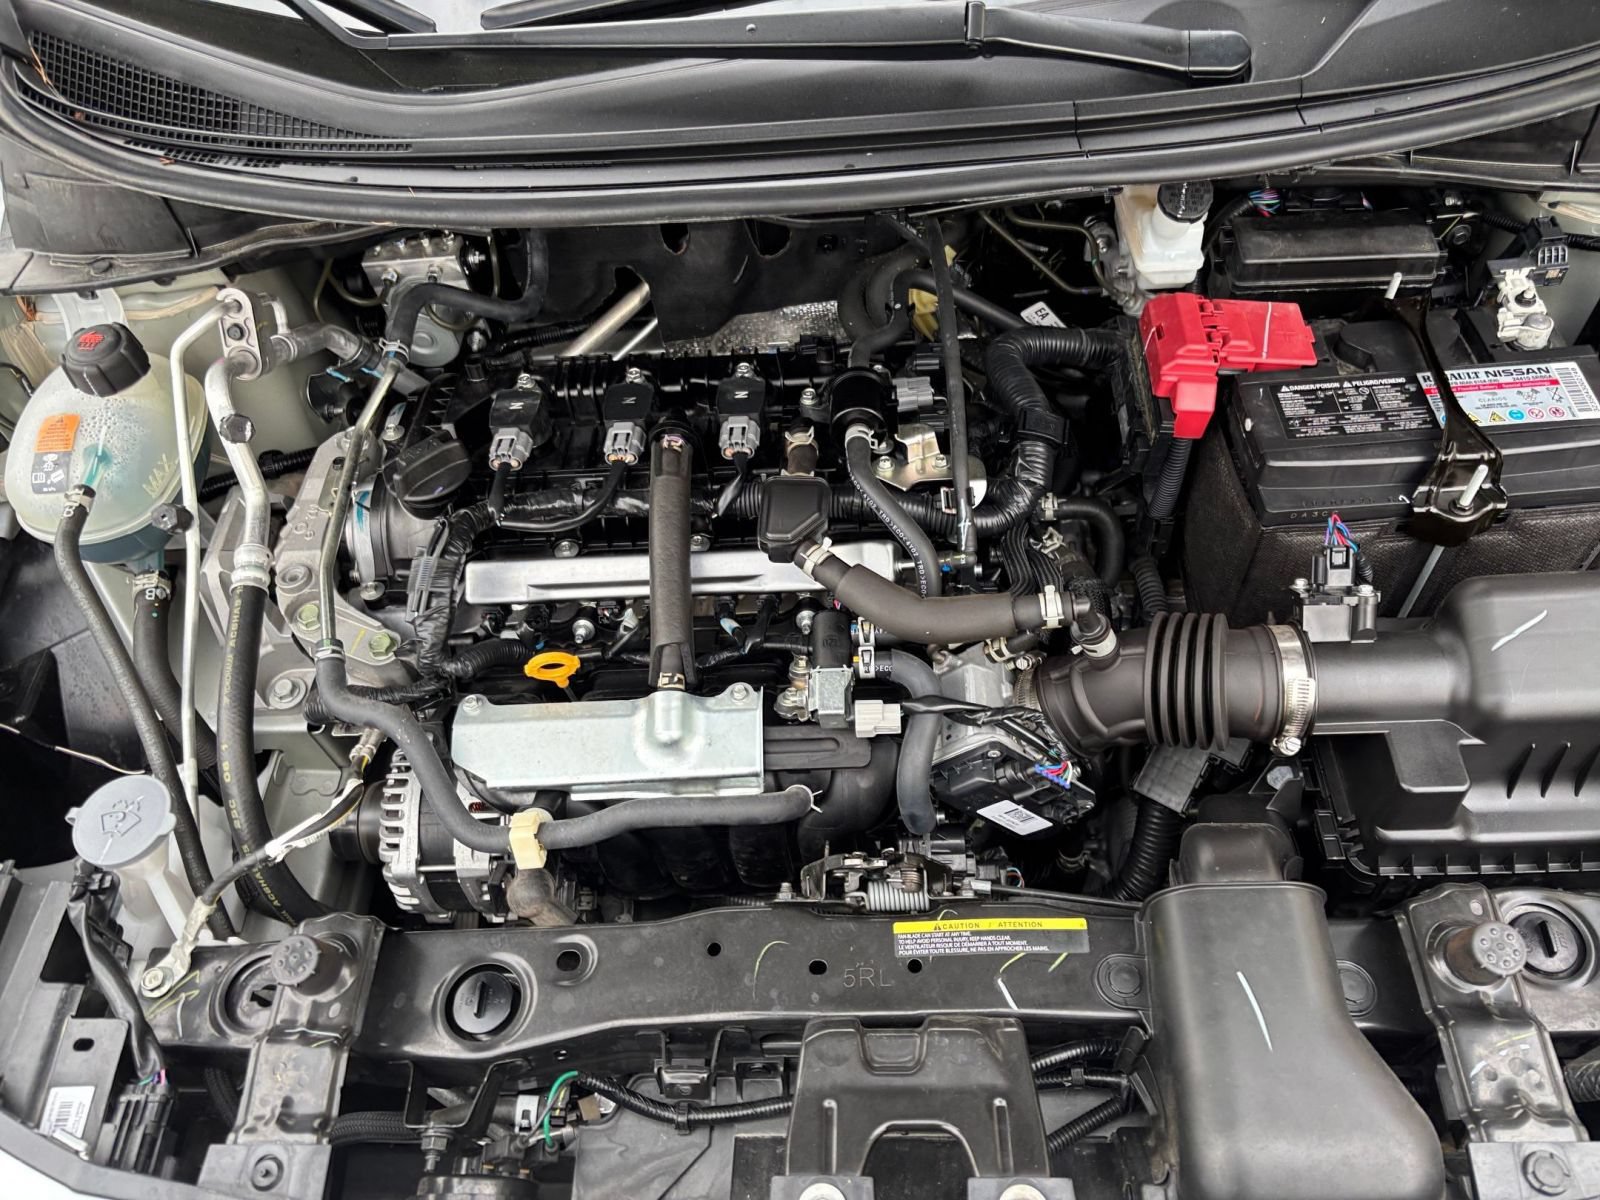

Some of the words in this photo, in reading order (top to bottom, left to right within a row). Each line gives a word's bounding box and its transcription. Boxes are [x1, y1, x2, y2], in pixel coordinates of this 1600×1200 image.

[1035, 307, 1050, 320] EA
[1421, 371, 1481, 384] RAULT
[1485, 366, 1551, 379] NISSAN
[142, 453, 170, 499] MAX
[943, 922, 980, 930] CAUTION
[843, 967, 893, 988] 5RL
